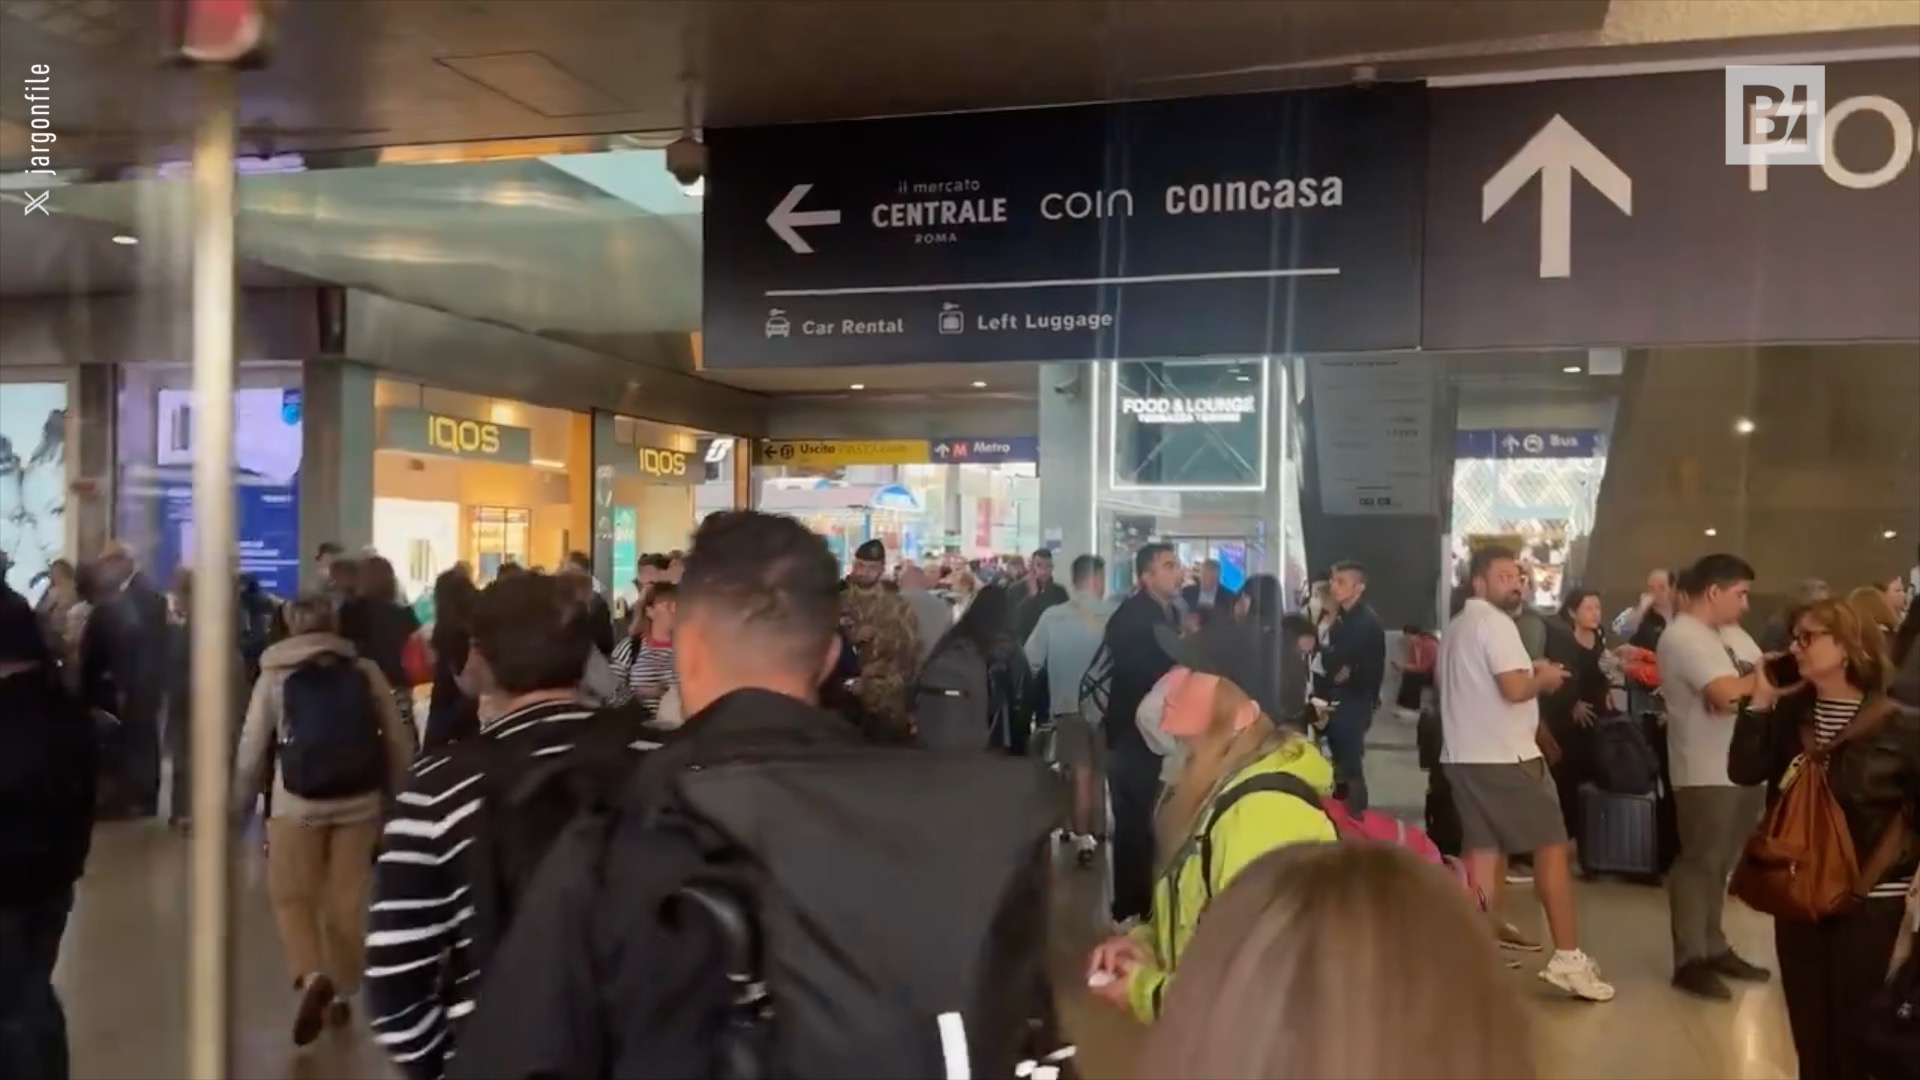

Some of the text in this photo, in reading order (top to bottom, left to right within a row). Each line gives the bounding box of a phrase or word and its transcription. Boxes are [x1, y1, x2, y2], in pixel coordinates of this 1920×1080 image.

[1749, 94, 1920, 192] FO
[898, 179, 980, 194] il mercato
[1165, 176, 1344, 215] coincasa
[872, 198, 1007, 228] CENTRALE
[1040, 189, 1134, 220] coin
[914, 233, 958, 245] ROMA
[802, 318, 904, 336] Car Rental
[977, 312, 1113, 333] Left Luggage
[1122, 395, 1256, 414] FOOD & LOUNGE
[429, 415, 500, 453] IQOS
[1550, 434, 1578, 448] Bus
[952, 442, 1011, 457] M Metro
[639, 447, 687, 476] IQOS
